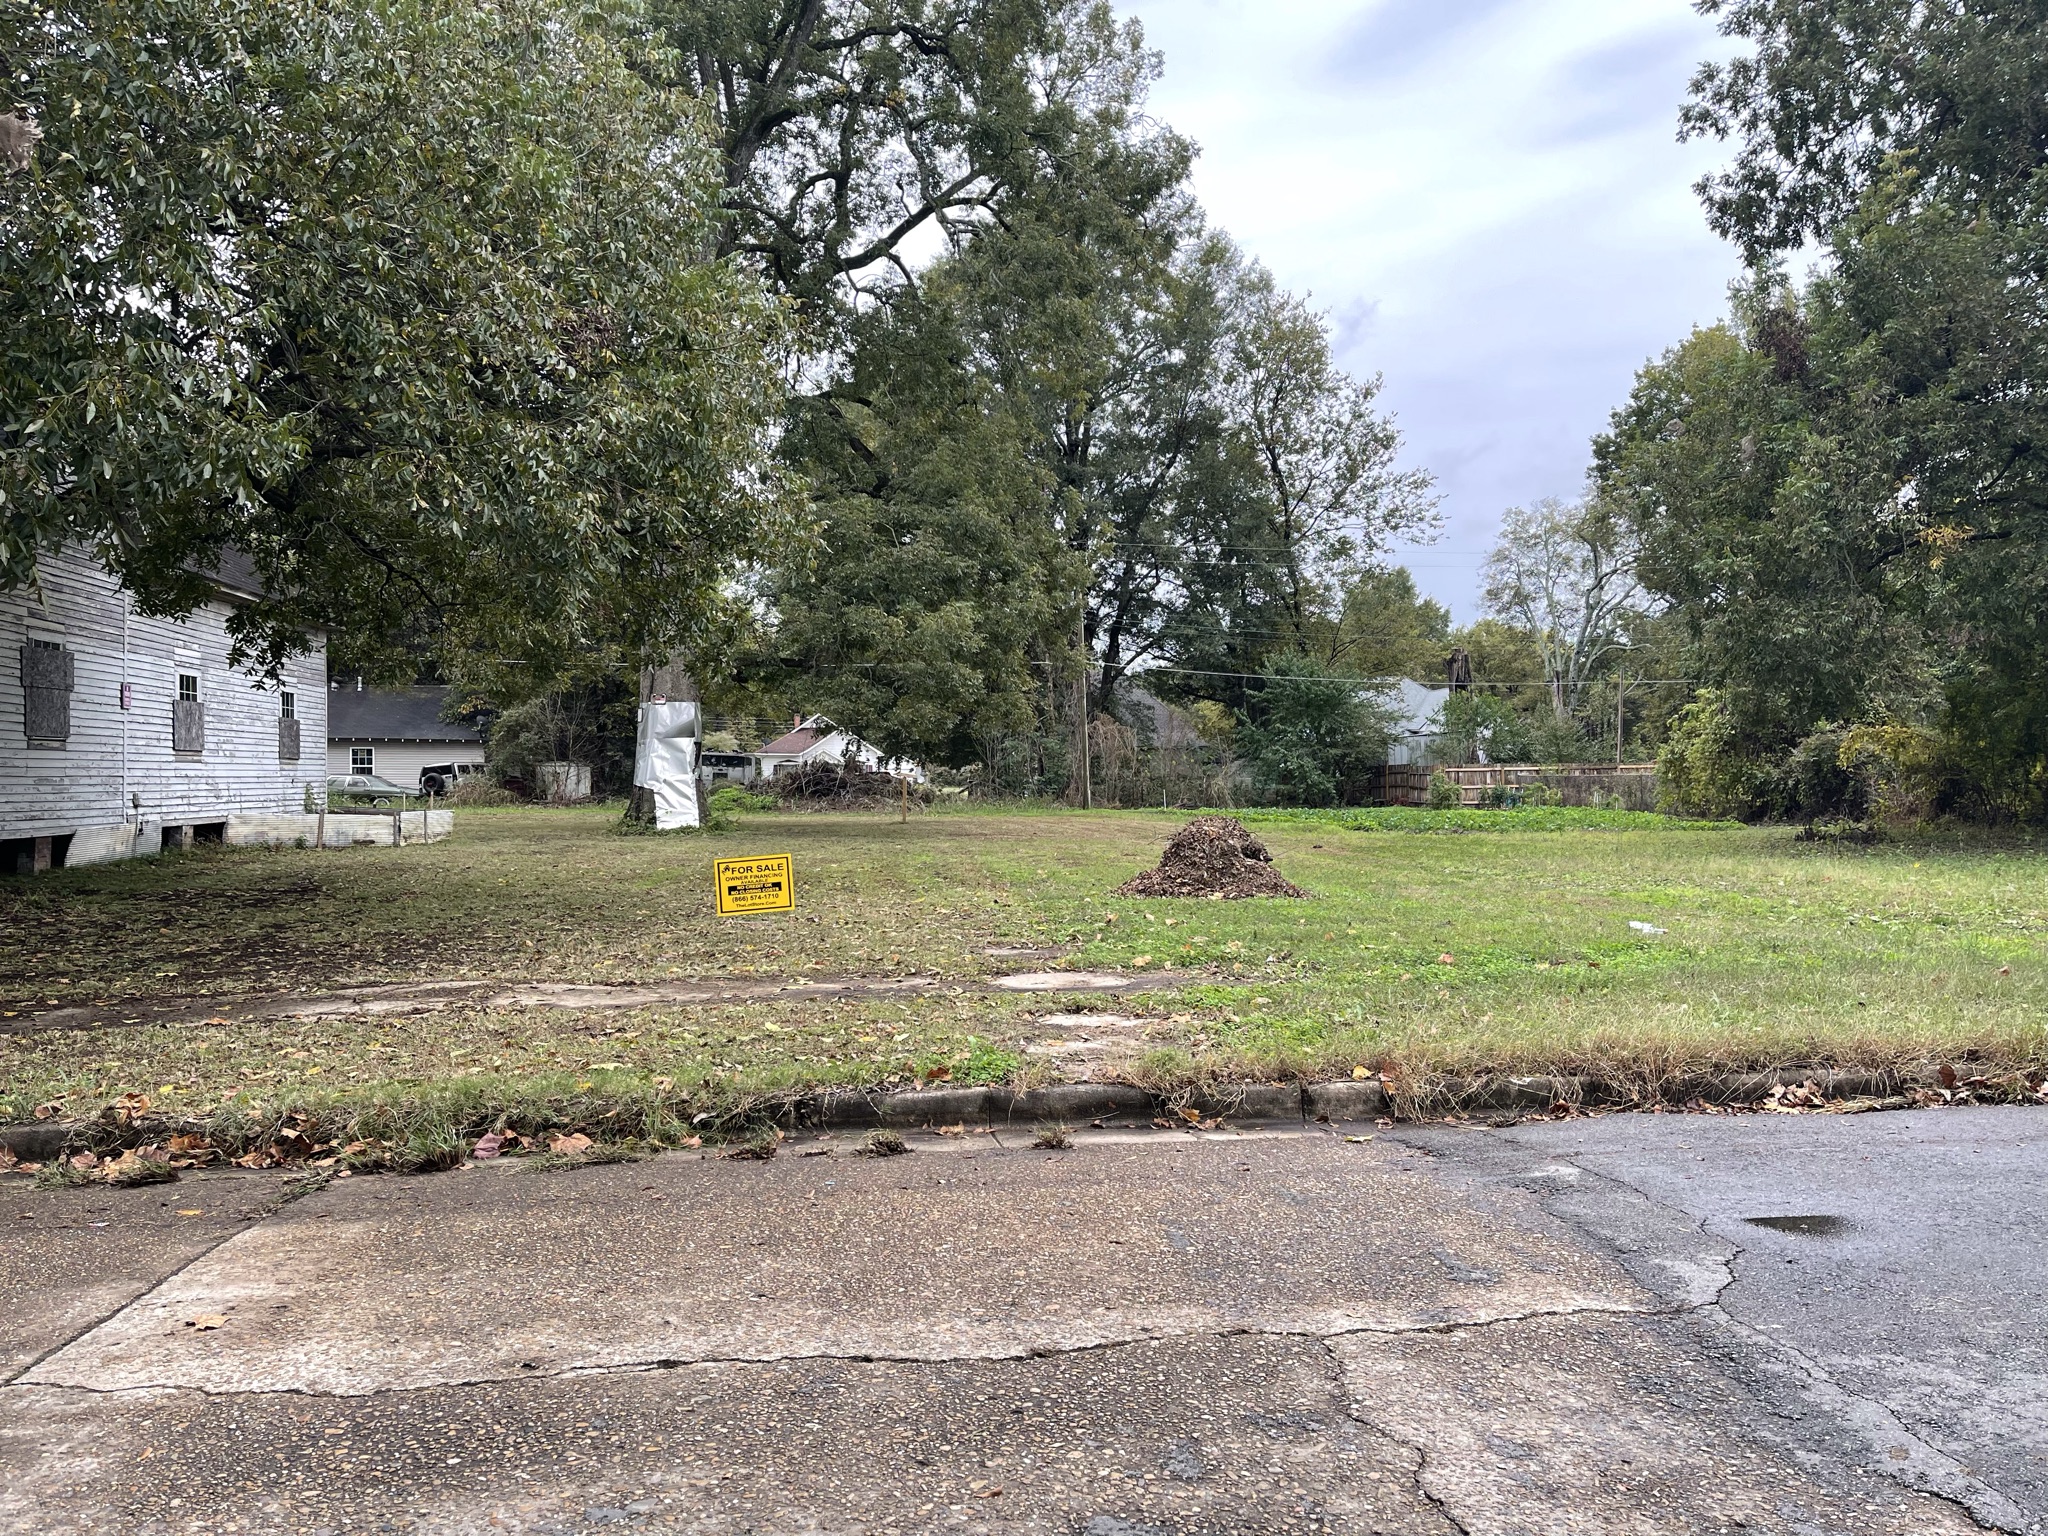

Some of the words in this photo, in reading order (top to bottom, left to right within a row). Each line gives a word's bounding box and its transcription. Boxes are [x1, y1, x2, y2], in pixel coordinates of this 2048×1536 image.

[731, 866, 753, 874] FOR
[756, 863, 784, 873] SALE
[750, 872, 783, 880] FINANCING
[750, 893, 779, 901] 574-1710
